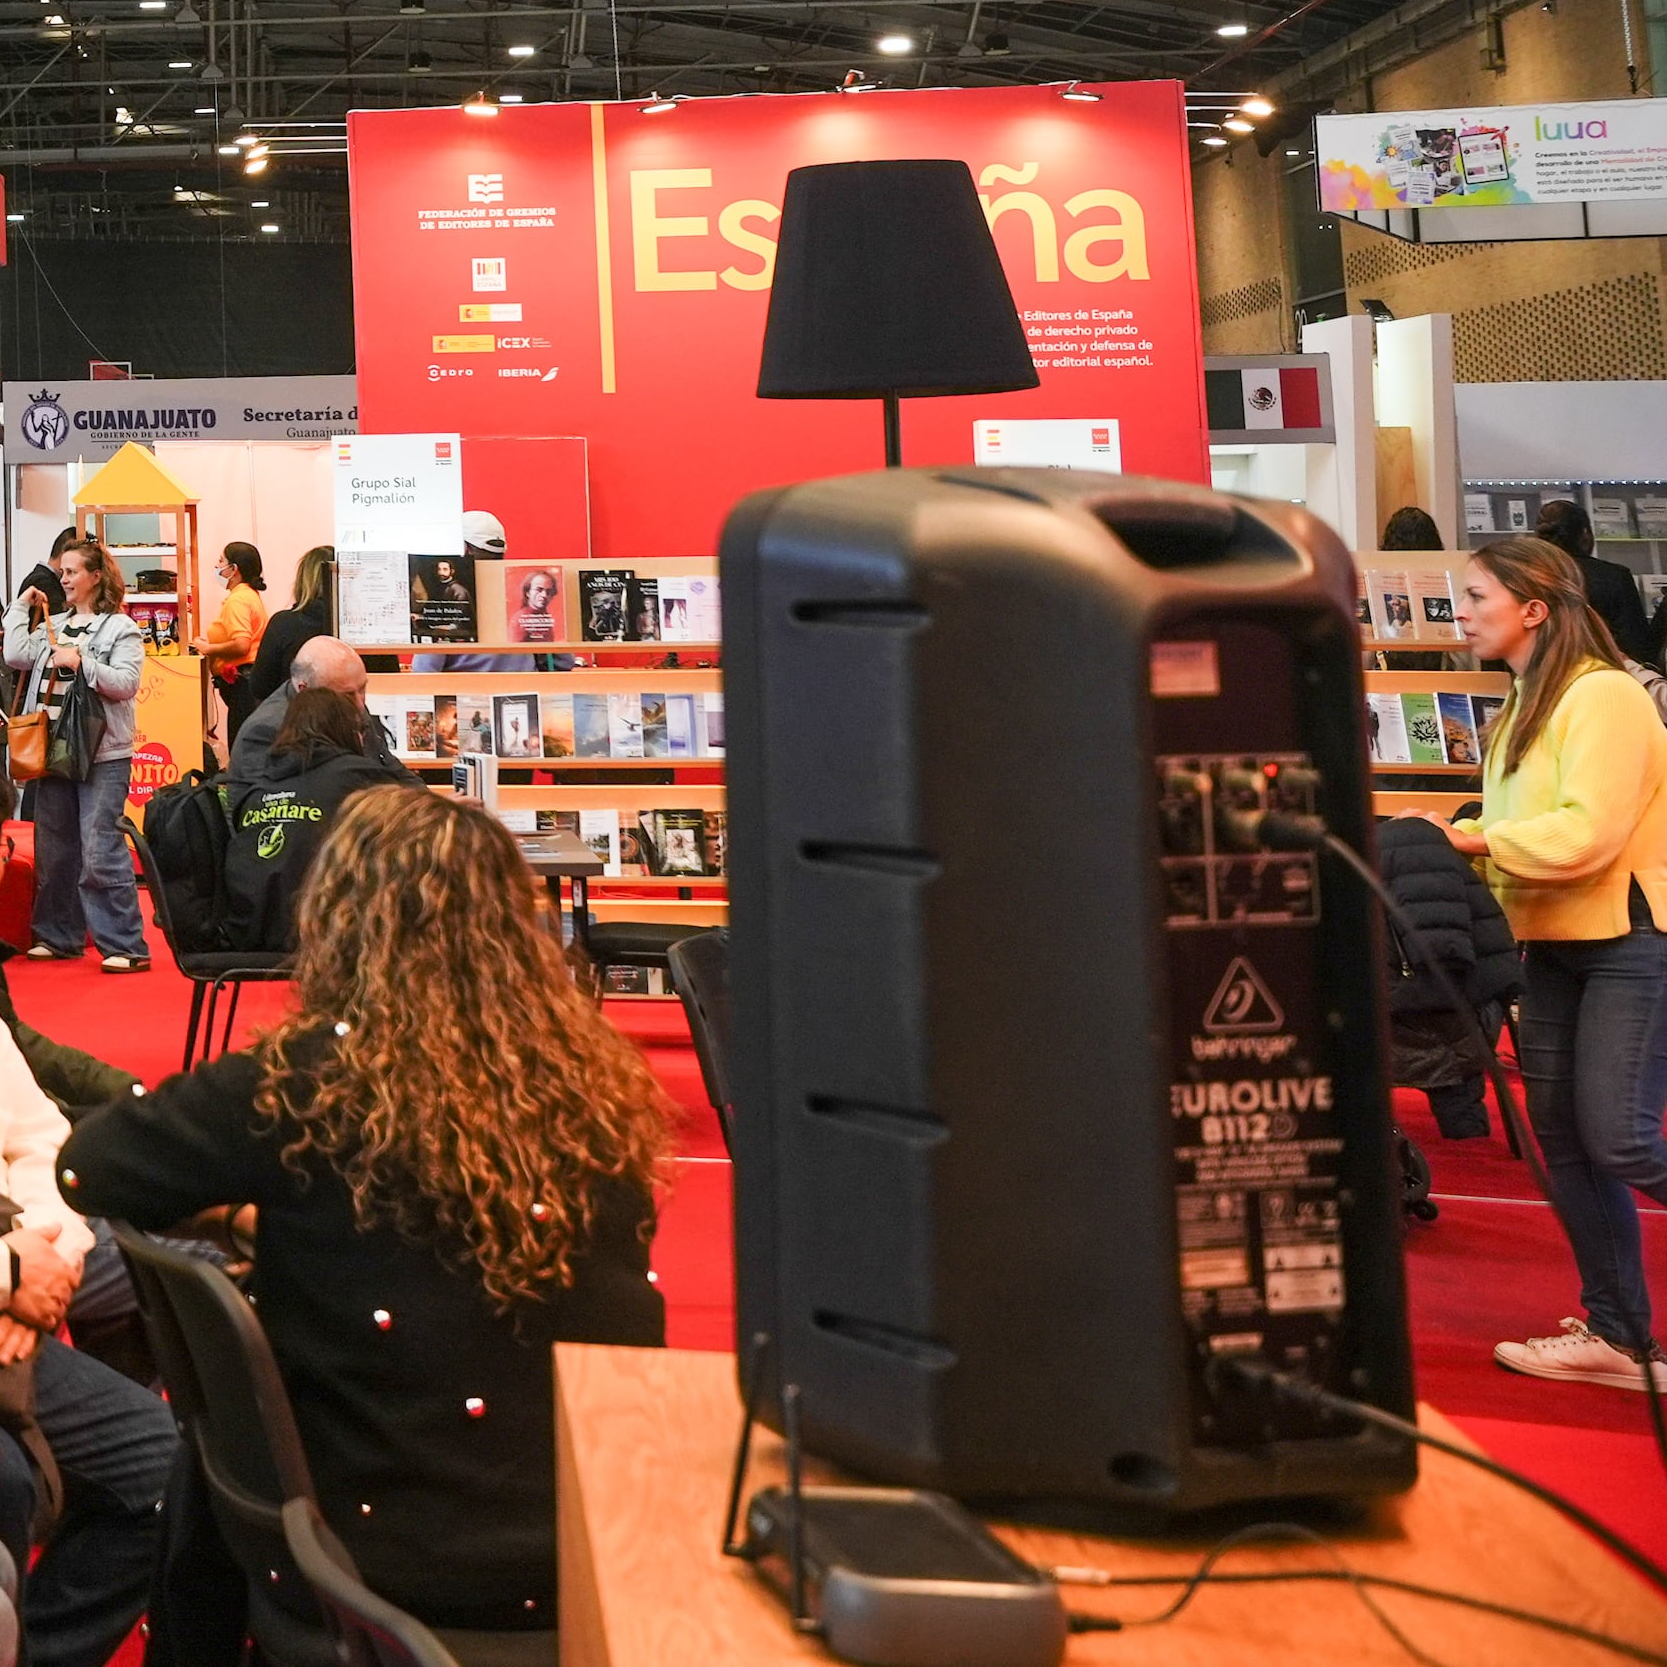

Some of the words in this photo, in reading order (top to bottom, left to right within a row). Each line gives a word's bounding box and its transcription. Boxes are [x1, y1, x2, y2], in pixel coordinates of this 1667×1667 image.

[1535, 115, 1608, 141] luua
[418, 208, 486, 219] FEDERACIÓN
[489, 208, 504, 217] DE
[506, 207, 556, 217] GREMIOS
[420, 221, 435, 230] DE
[438, 220, 492, 229] EDITORES
[495, 220, 509, 228] DE
[513, 217, 555, 228] ESPAÑA
[630, 161, 1151, 293] Esña
[1024, 310, 1072, 321] Editores
[1074, 309, 1089, 320] de
[1091, 309, 1133, 322] España
[1027, 325, 1042, 336] de
[1044, 325, 1092, 336] derecho
[1094, 324, 1138, 338] privado
[1028, 341, 1078, 352] entación
[1080, 342, 1087, 353] y
[1090, 340, 1135, 351] defensa
[1138, 339, 1153, 350] de
[1032, 358, 1050, 368] tor
[1052, 356, 1101, 367] editorial
[1104, 355, 1153, 369] español.
[498, 369, 542, 377] IBERIA
[73, 409, 217, 431] GUANAJUATO
[243, 406, 341, 422] Secretaría
[344, 406, 358, 421] d
[91, 431, 138, 439] GOBIERNO
[170, 430, 200, 438] GENTE
[286, 426, 356, 438] Guanajuato
[351, 477, 390, 491] Grupo
[393, 477, 416, 488] Sial
[352, 493, 415, 507] Pigmalión
[133, 753, 164, 763] PEZAR
[131, 763, 177, 785] NITO
[242, 804, 323, 827] Casanare
